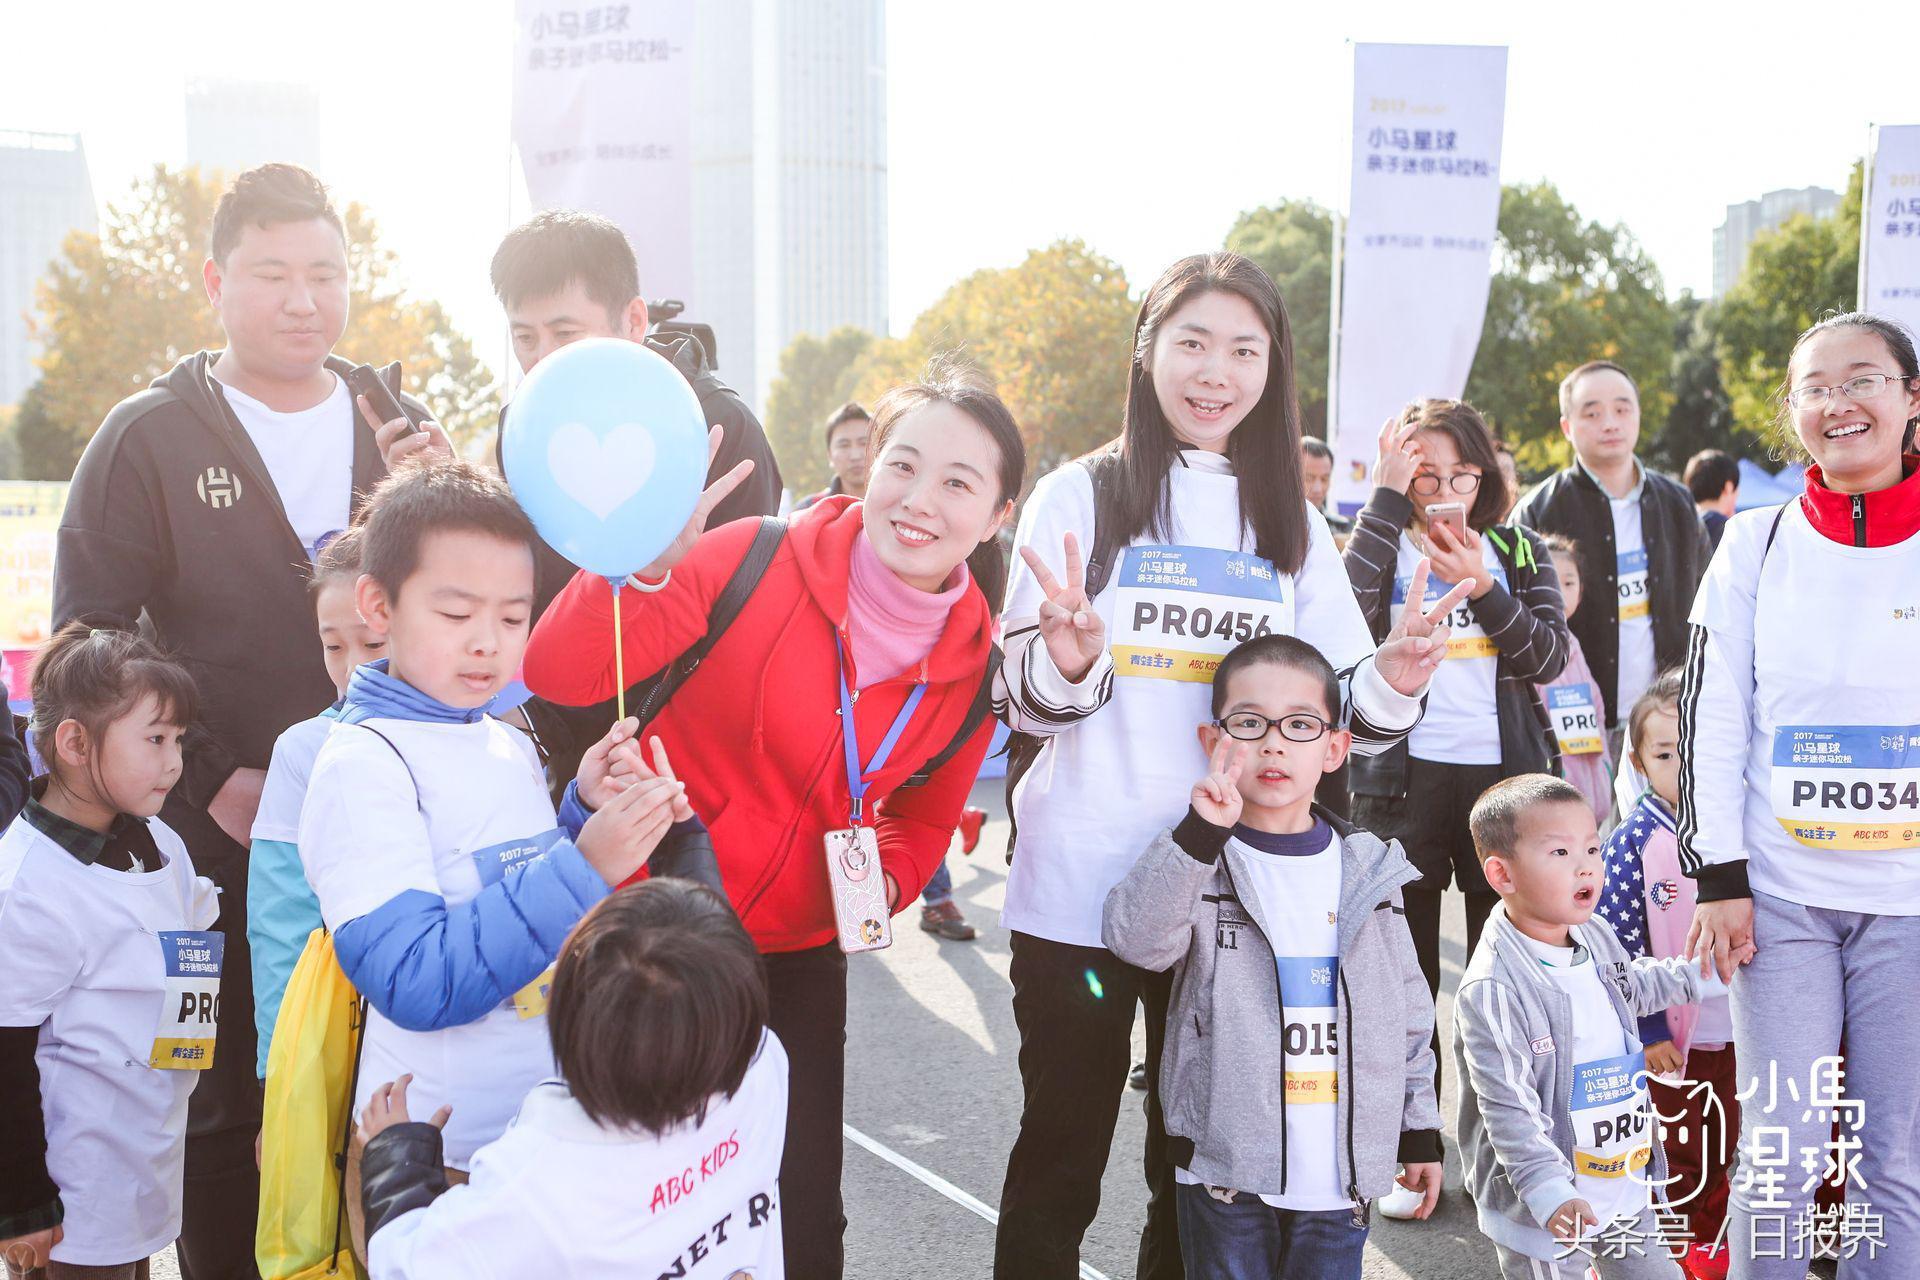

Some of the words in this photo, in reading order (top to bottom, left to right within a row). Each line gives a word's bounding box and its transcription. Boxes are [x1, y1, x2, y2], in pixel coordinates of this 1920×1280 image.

[530, 4, 631, 41] 小马星球
[1368, 126, 1458, 151] 小马星球
[1886, 222, 1920, 236] 亲子
[1138, 561, 1187, 575] 小马星球
[1137, 574, 1198, 587] 亲子迷你马拉松
[1131, 654, 1174, 668] 青蛙王子
[1189, 660, 1204, 669] ABC
[1793, 742, 1840, 754] 小马星球
[1793, 754, 1852, 764] 亲子迷你马拉松
[1795, 827, 1836, 840] 青蛙王子
[1853, 830, 1870, 839] ABC
[1872, 830, 1889, 839] KIDS
[500, 848, 521, 862] 2017
[176, 938, 190, 946] 2017
[178, 949, 210, 962] 小马星球
[1582, 1068, 1601, 1078] 2017
[1301, 1080, 1317, 1090] KIDS
[1584, 1073, 1630, 1092] 小马星球
[650, 1168, 694, 1214] ABC
[700, 1129, 739, 1182] KIDS
